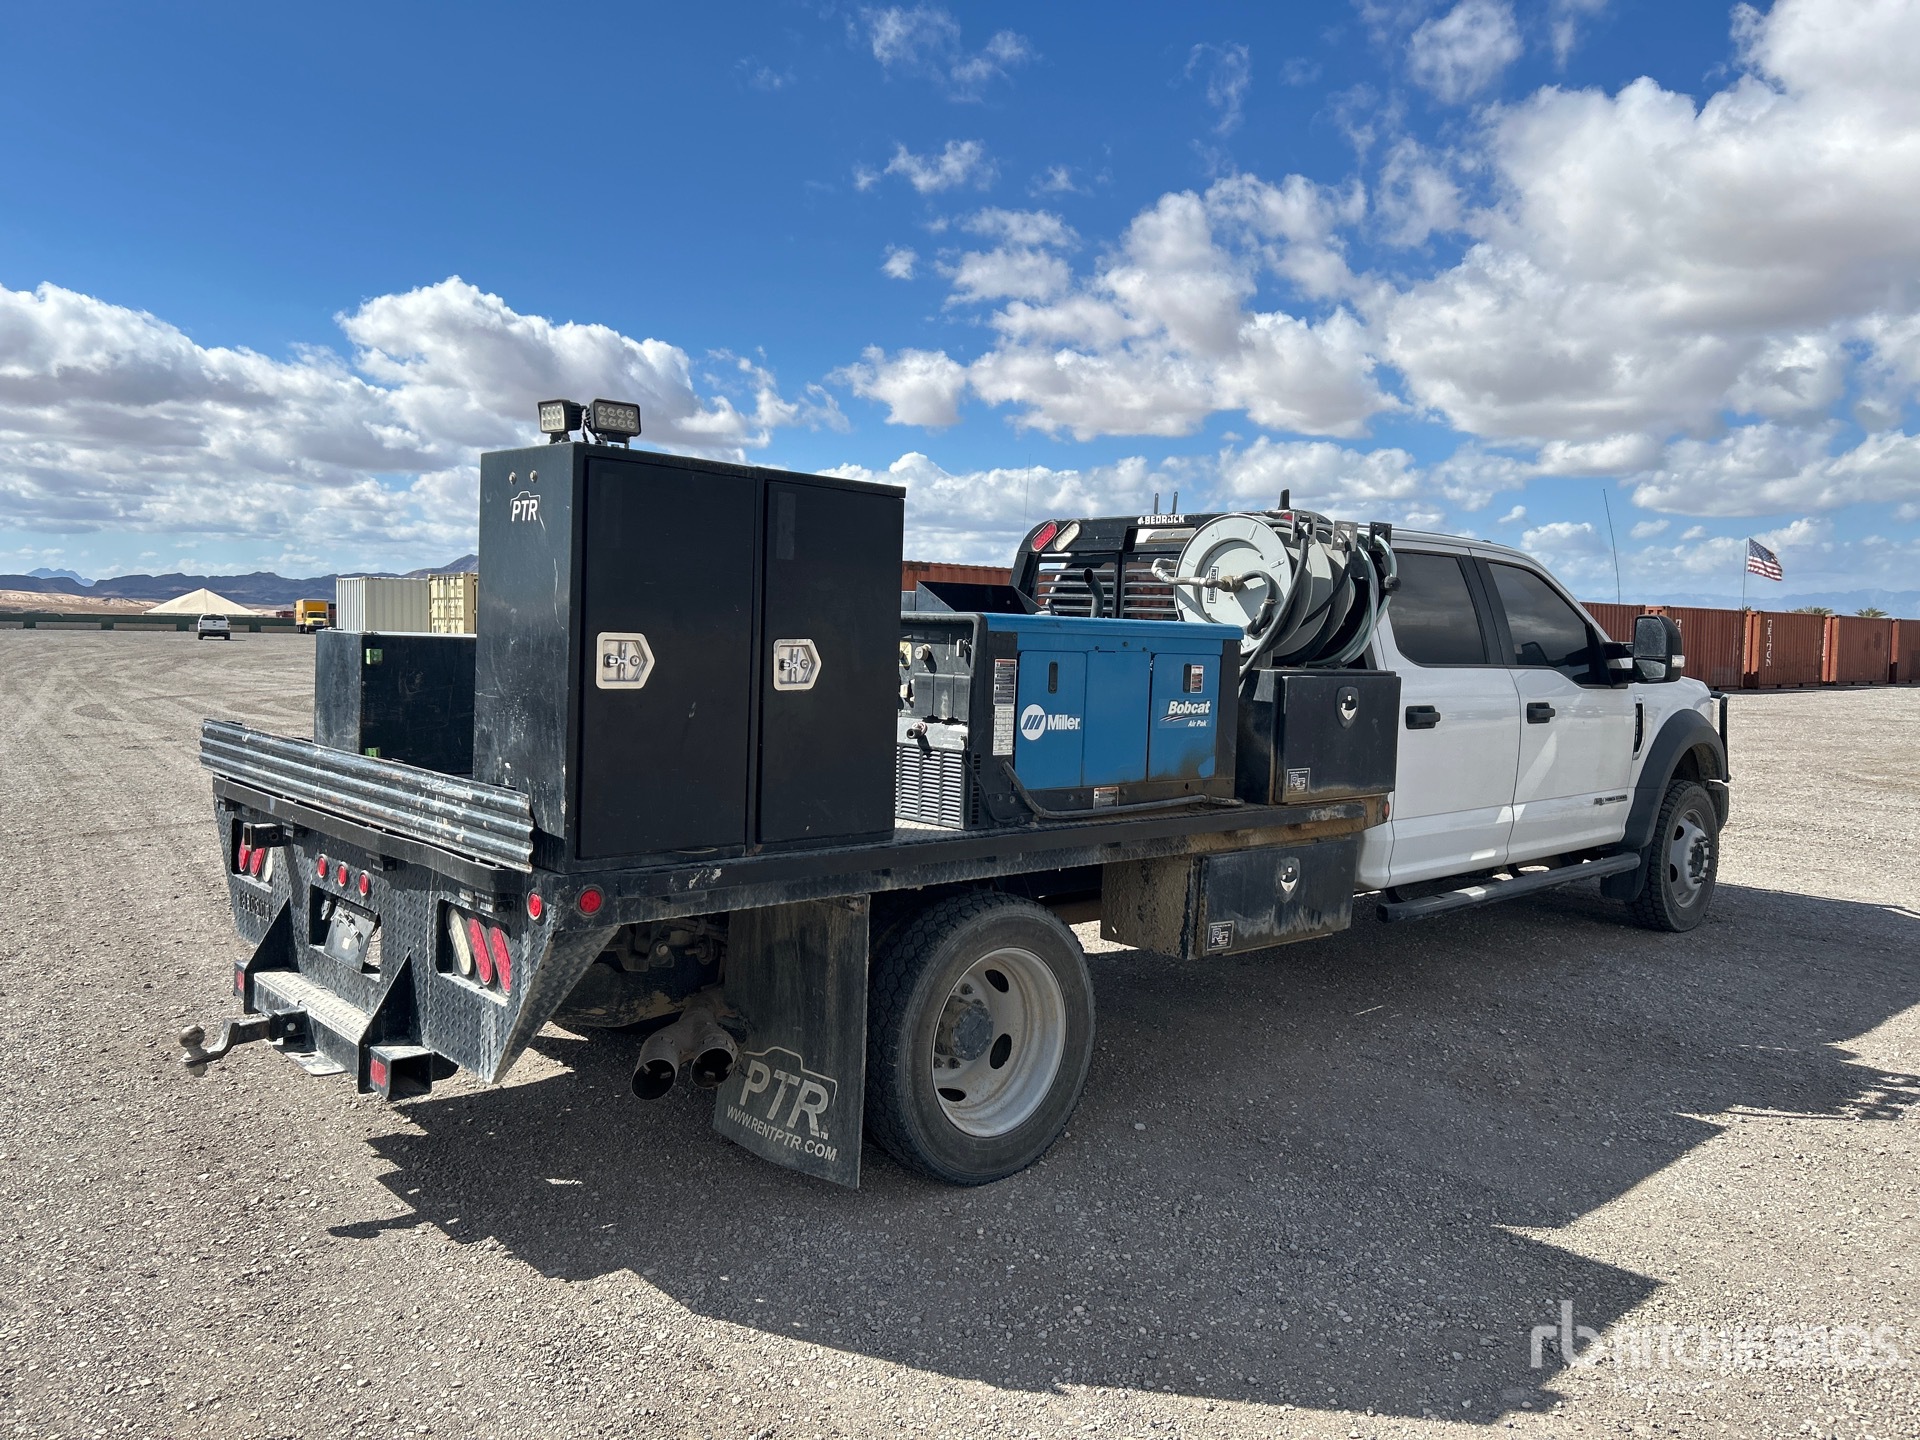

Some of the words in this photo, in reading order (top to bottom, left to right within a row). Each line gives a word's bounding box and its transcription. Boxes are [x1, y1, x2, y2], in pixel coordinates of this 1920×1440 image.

[511, 499, 538, 521] PTR
[1167, 700, 1211, 715] Bobcat
[1047, 714, 1080, 730] Miller
[739, 1059, 829, 1138] PTR
[727, 1105, 838, 1161] WWW.RENTPTR.COM
